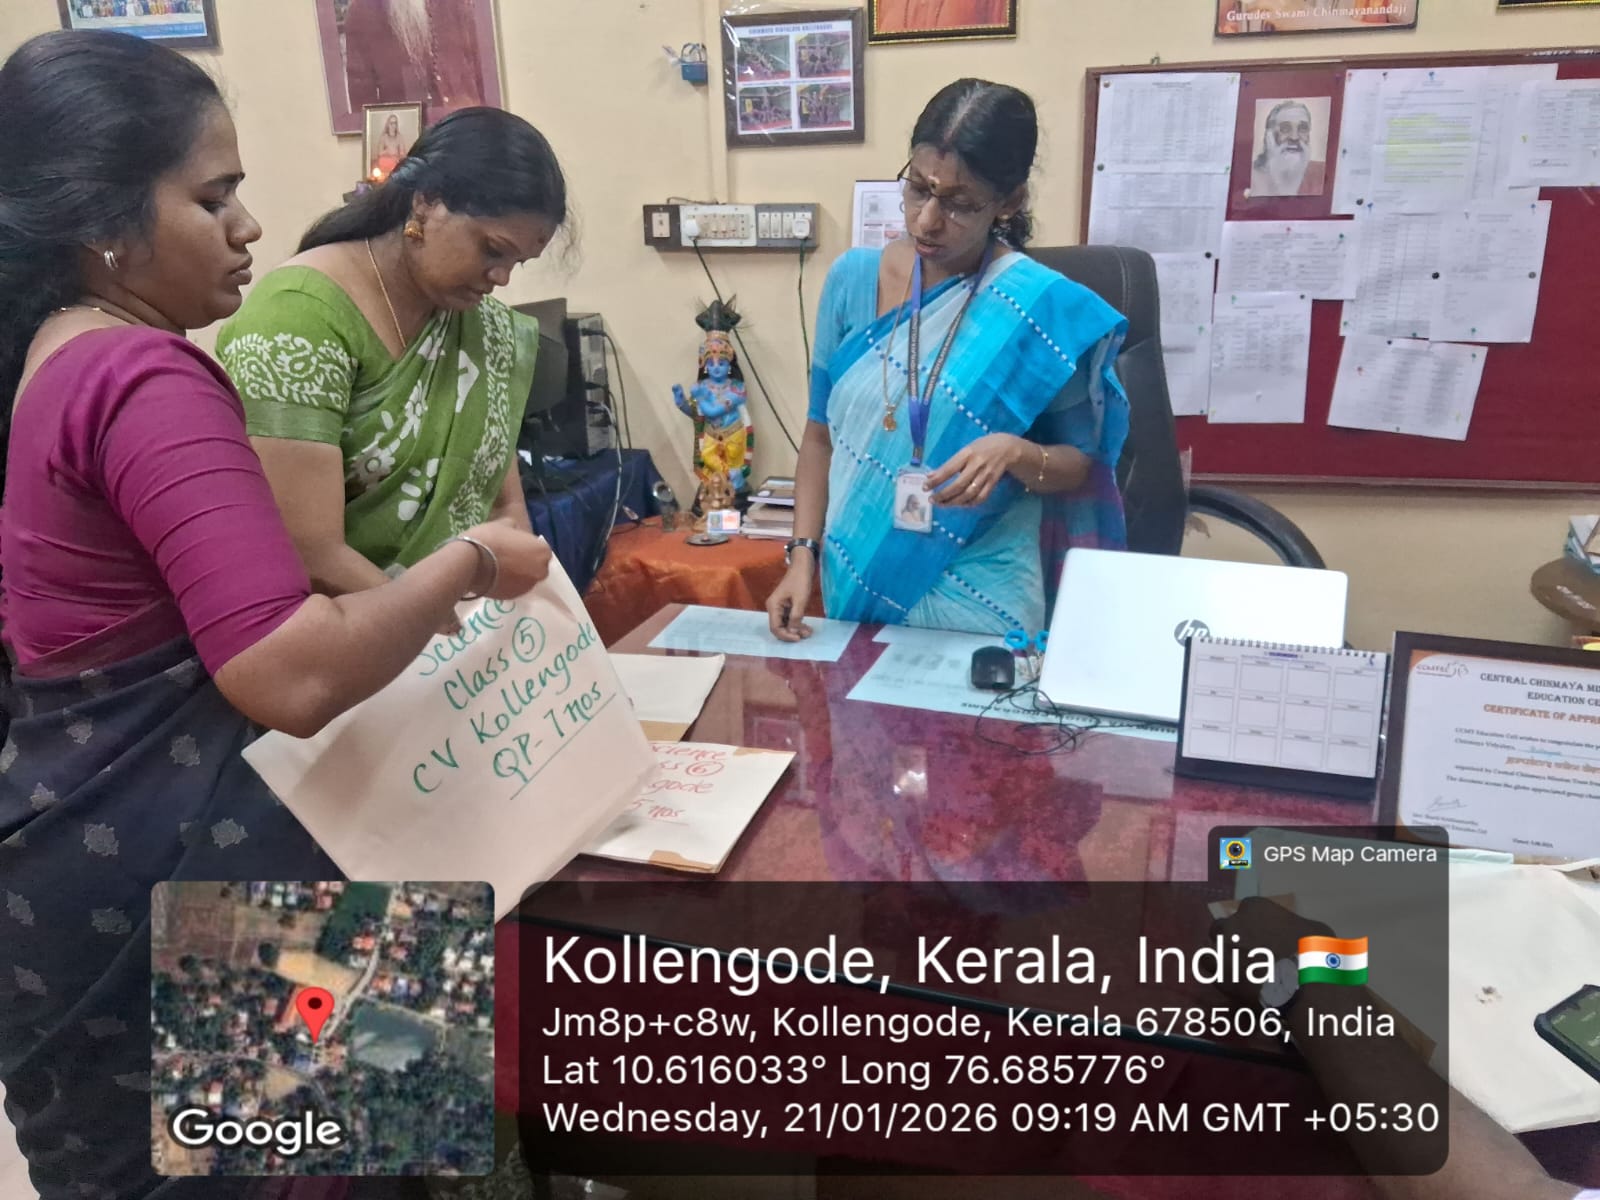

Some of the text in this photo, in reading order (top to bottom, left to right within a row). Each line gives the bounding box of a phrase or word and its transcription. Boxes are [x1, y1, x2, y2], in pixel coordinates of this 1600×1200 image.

[1226, 4, 1408, 21] Gurudev Swami Chinmayanandaji
[444, 647, 510, 710] Class
[470, 621, 597, 744] Kollengode
[1480, 672, 1527, 686] CENTRAL
[1529, 677, 1584, 692] CHINMAYA
[563, 681, 602, 723] nos
[1528, 691, 1586, 705] EDUCATION
[1483, 703, 1550, 719] CERTIFICATE
[1552, 711, 1566, 719] OF
